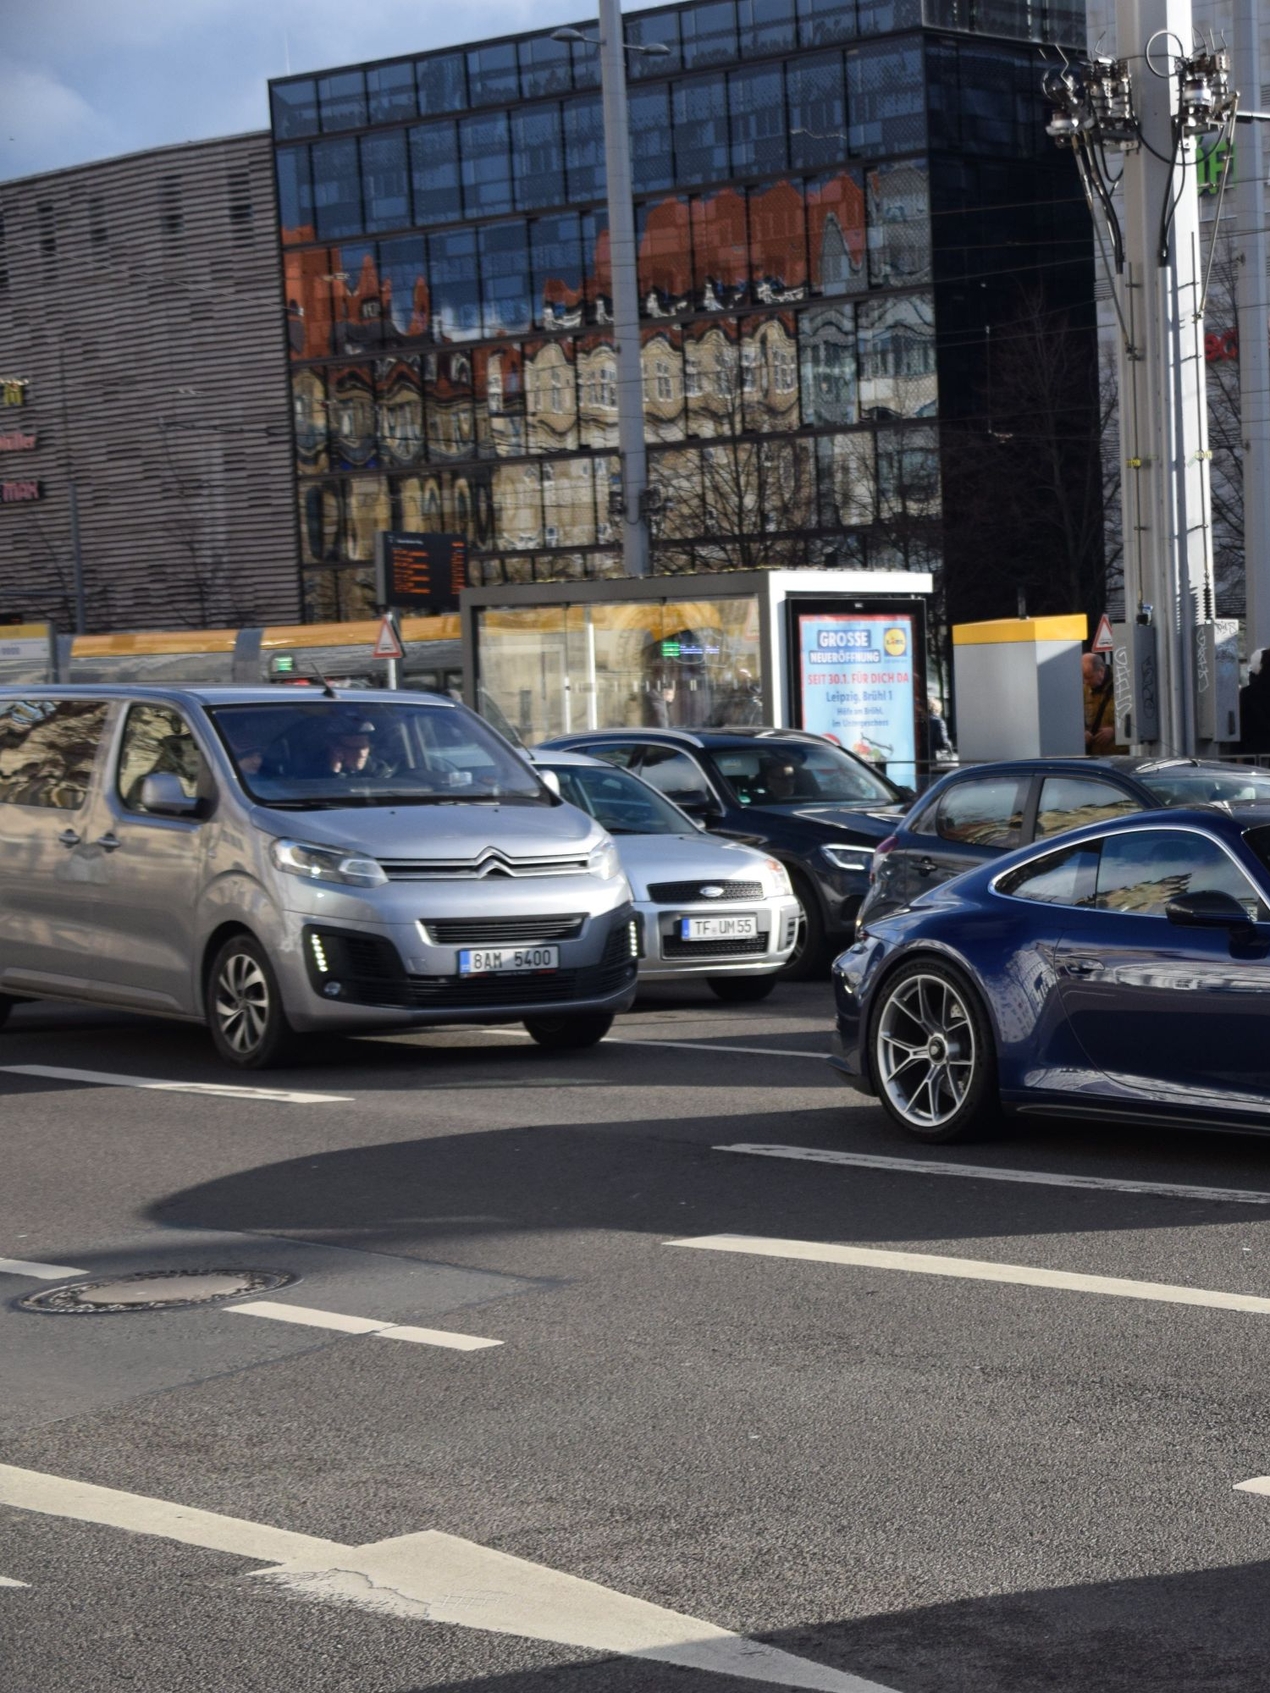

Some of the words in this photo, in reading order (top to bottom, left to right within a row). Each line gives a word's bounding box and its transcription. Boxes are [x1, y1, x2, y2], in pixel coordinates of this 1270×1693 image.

[819, 631, 868, 648] GROSSE
[810, 650, 880, 664] NEUERÖFFNUNG
[808, 674, 826, 685] SEIT
[852, 670, 869, 684] FÜR
[872, 672, 895, 684] DICH
[896, 671, 909, 683] DA
[863, 690, 887, 702] Brühl
[695, 920, 711, 935] TF
[719, 920, 735, 934] UM
[737, 919, 752, 933] 55
[474, 952, 503, 970] 8AM
[514, 949, 552, 967] 5400
